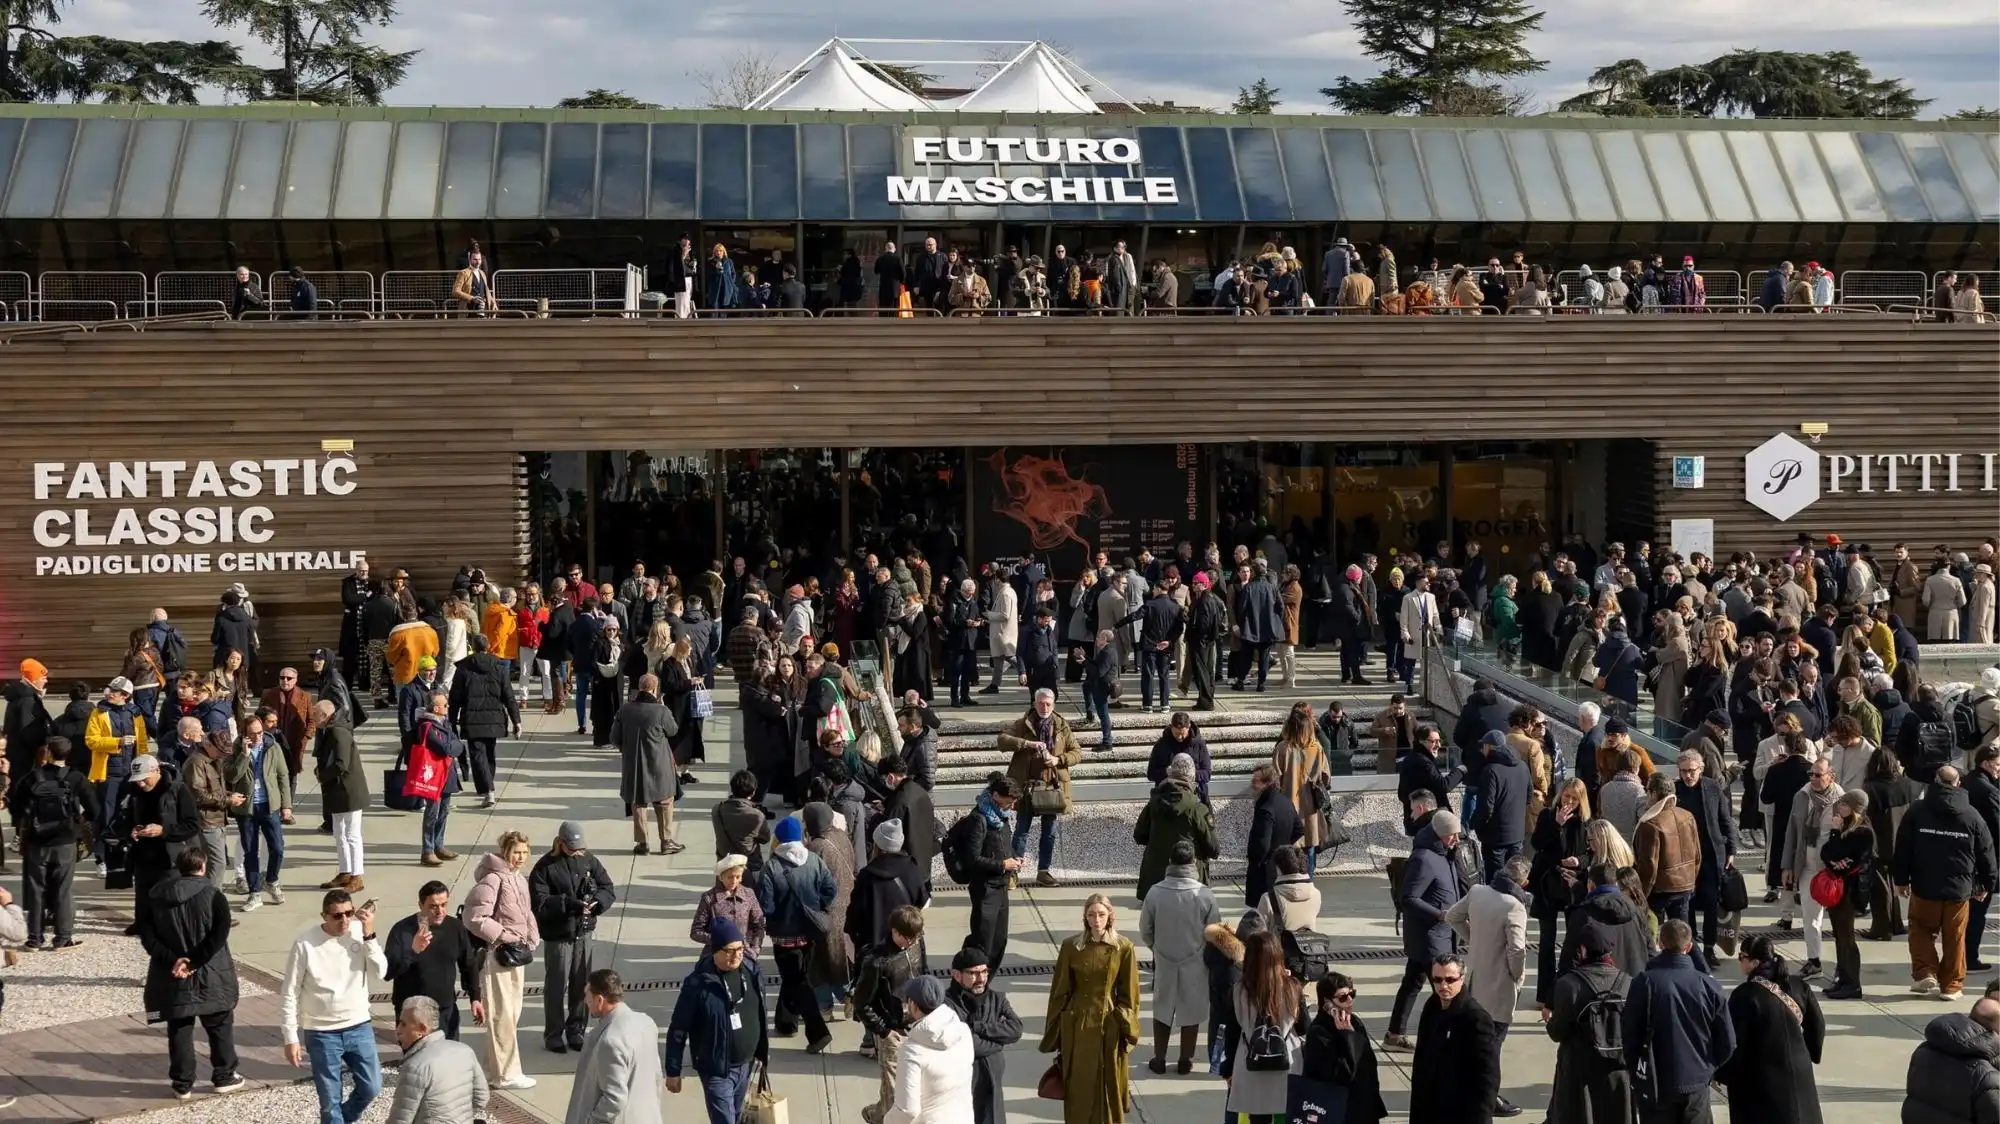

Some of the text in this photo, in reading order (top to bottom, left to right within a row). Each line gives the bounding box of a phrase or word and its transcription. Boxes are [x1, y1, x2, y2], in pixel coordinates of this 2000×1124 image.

[913, 136, 1141, 164] FUTURO
[886, 175, 1180, 205] MASCHILE
[34, 458, 358, 500] FANTASTIC
[1826, 453, 1962, 493] PITTI
[33, 506, 275, 547] CLASSIC
[36, 550, 367, 576] PADIGLIONE CENTRALE
